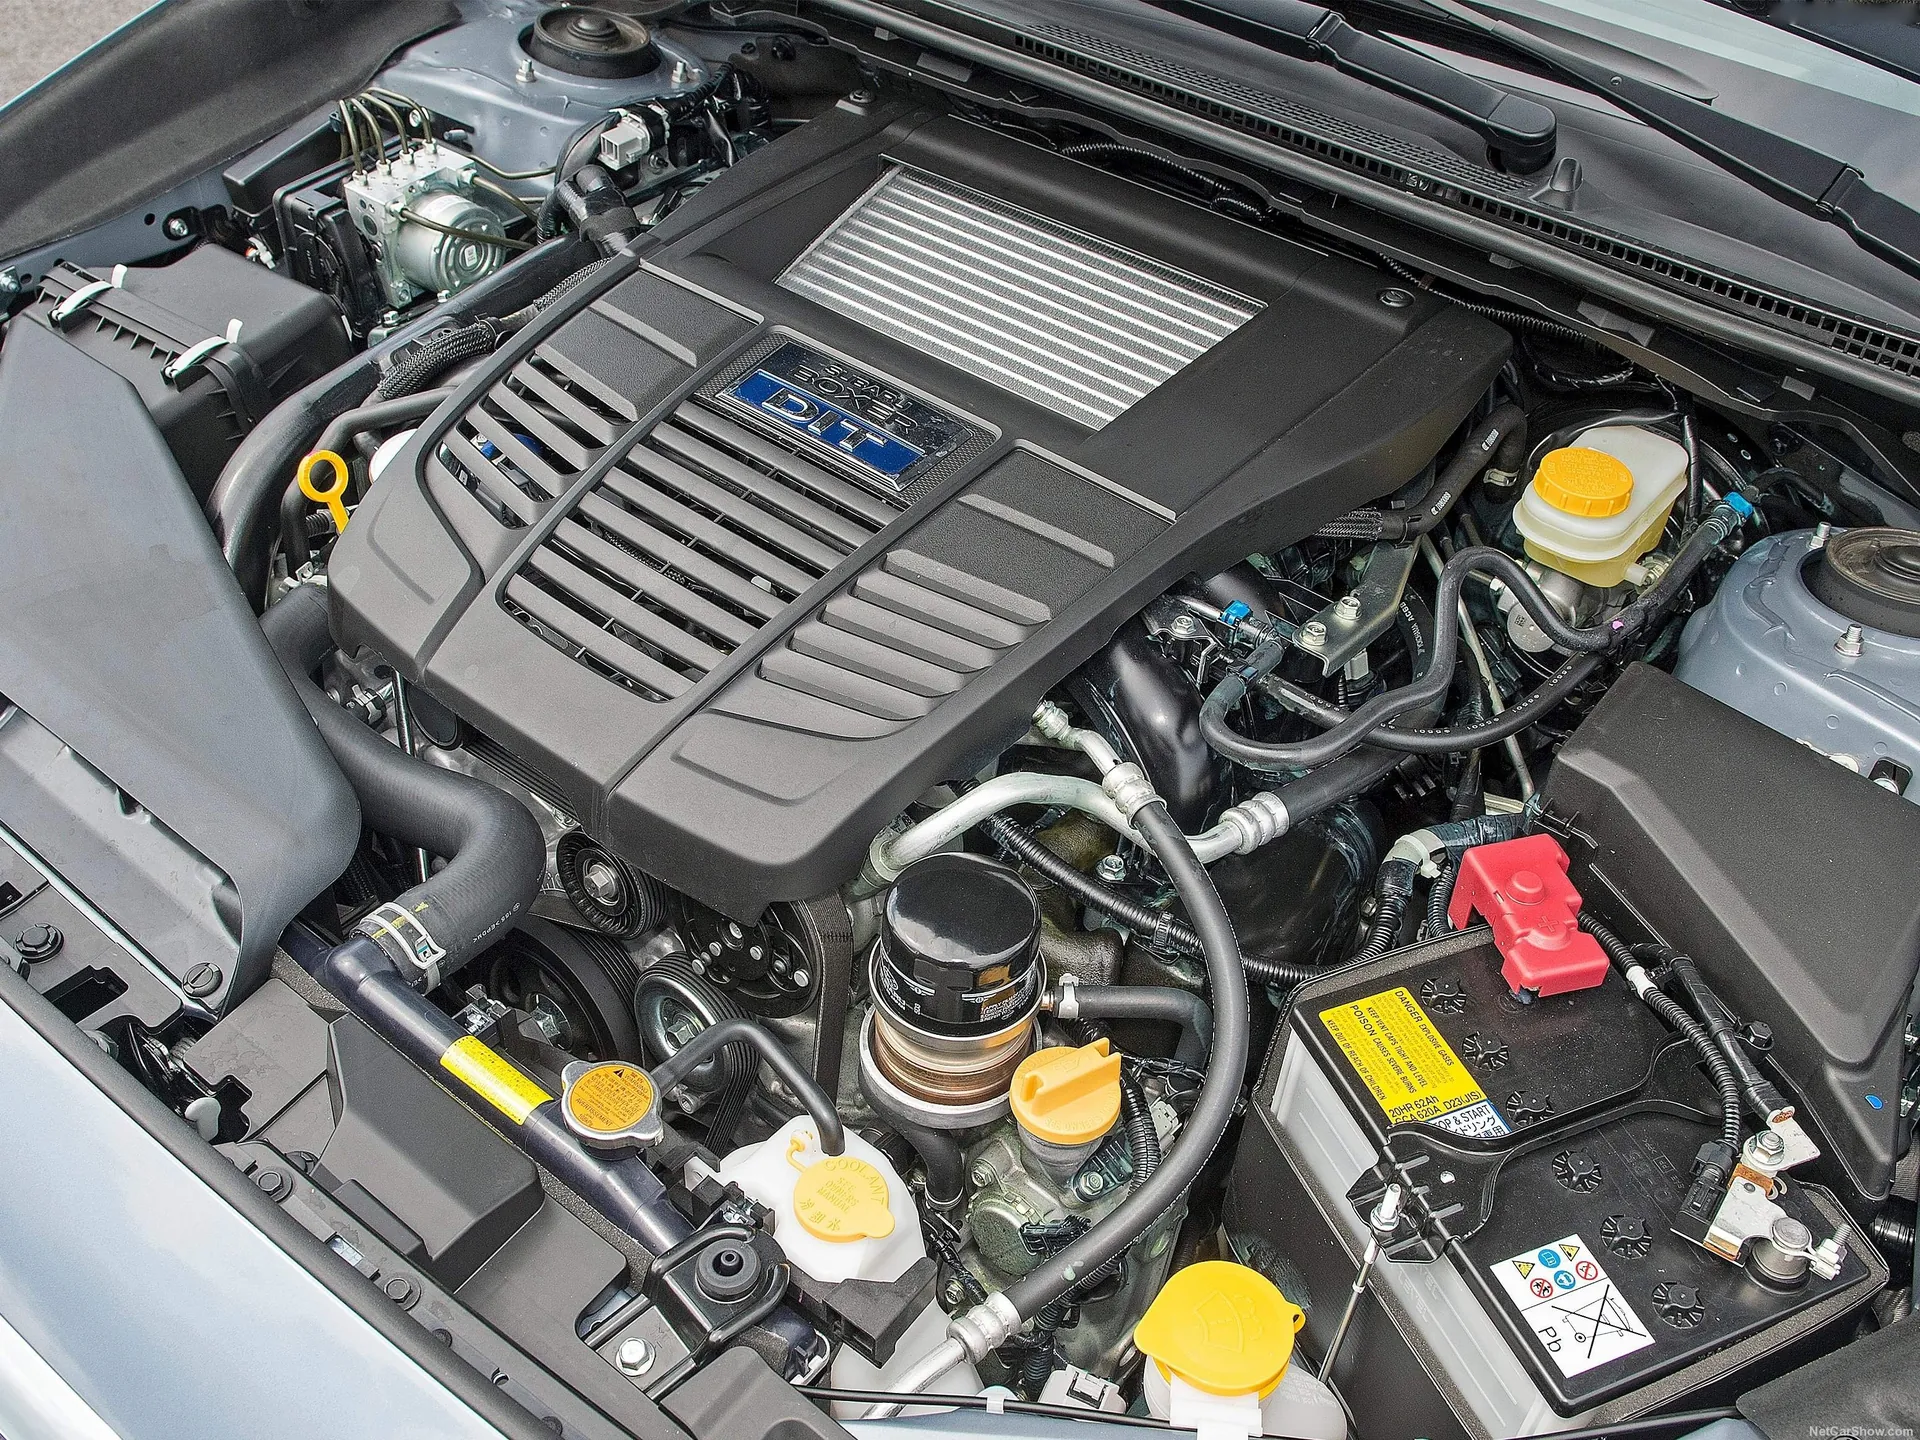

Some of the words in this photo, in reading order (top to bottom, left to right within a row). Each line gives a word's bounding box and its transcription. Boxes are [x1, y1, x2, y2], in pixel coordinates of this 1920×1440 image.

[793, 364, 918, 434] BOXER
[825, 363, 914, 412] SUBARU
[761, 387, 888, 452] DIT
[1349, 1004, 1377, 1037] POISON
[1373, 1037, 1391, 1057] CAUSES
[1386, 1056, 1405, 1076] SEVERE
[1400, 1074, 1418, 1094] BURNS
[1366, 1006, 1379, 1019] KEEP
[1376, 1018, 1389, 1034] VENT
[1384, 1031, 1398, 1046] CAPS
[1395, 1044, 1409, 1060] TIGHT
[1405, 1060, 1418, 1072] AND
[1414, 1070, 1429, 1088] LEVEL
[1395, 990, 1423, 1023] DANGER
[1419, 1023, 1442, 1050] EXPLOSIVE
[1438, 1049, 1455, 1067] GASES
[1327, 1019, 1340, 1033] KEEP
[1335, 1031, 1347, 1043] OUT
[1342, 1041, 1352, 1050] OF
[1348, 1049, 1364, 1068] REACH
[1359, 1065, 1369, 1074] OF
[1364, 1074, 1387, 1101] CHILDREN
[1389, 1104, 1415, 1118] 20HR
[1415, 1095, 1440, 1111] 62Ah
[1417, 1105, 1442, 1120] 620A
[1443, 1091, 1482, 1110] D23(JIS)
[1453, 1115, 1462, 1126] &
[1461, 1104, 1491, 1122] START
[824, 1158, 885, 1205] COOLANT
[1538, 1325, 1562, 1353] Pb
